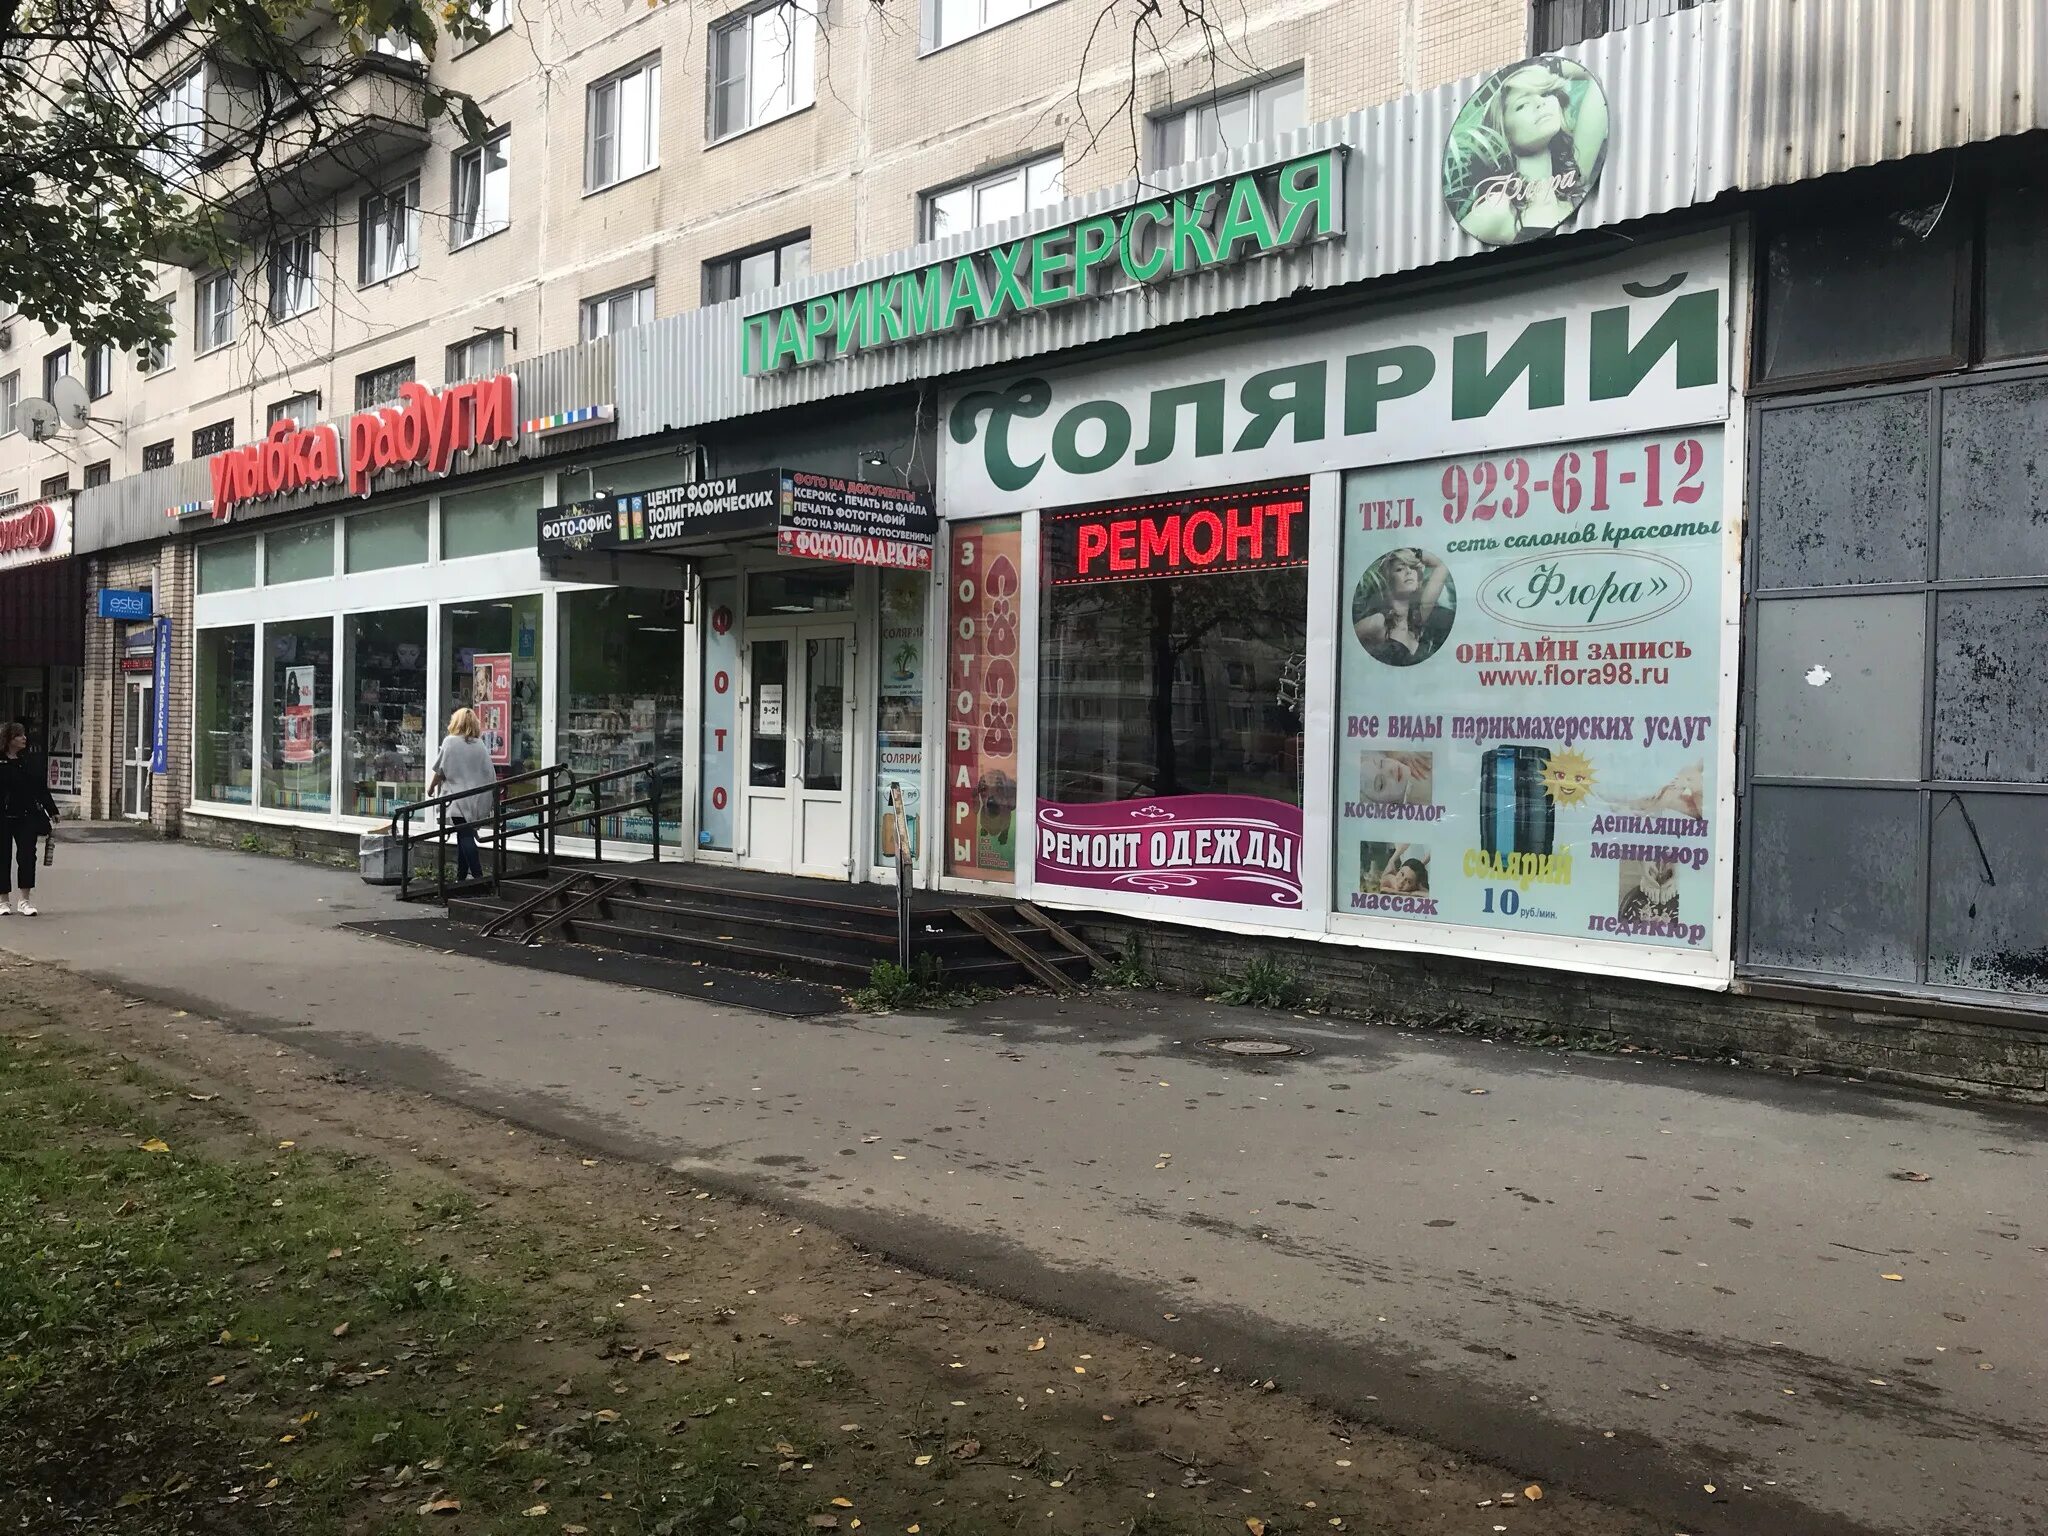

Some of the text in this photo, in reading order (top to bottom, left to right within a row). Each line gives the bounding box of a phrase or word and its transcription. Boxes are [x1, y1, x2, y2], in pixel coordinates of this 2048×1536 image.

[743, 150, 1331, 376] ПАРИКМАХЕРСКАЯ
[350, 374, 514, 497] радуги
[647, 477, 737, 507] ЦЕНТР ФОТО И
[794, 473, 916, 502] ФОТО НА ДОКУМЕНТЫ
[1359, 439, 1705, 531] ТЕЛ. 923-61-12
[648, 490, 774, 524] ПОЛИГРАФИЧЕСКИХ
[794, 487, 928, 516] КСЕРОКС ПЕЧАТЬ ИЗ ФАЙЛА
[794, 501, 906, 527] ПЕЧАТЬ ФОТОГРАФИЙ
[542, 513, 613, 539] ФОТО-ОФИС
[649, 521, 685, 540] УСЛУГ
[793, 516, 932, 543] ФОТО НА ЭМАЛИ ФОТОСУВЕНИРЫ
[1078, 501, 1303, 574] РЕМОНТ
[1446, 520, 1722, 553] сеть салонов красоты
[796, 532, 918, 567] ФОТОПОДАРКИ
[110, 597, 144, 611] estel
[1497, 562, 1668, 623] «Флора»
[1456, 636, 1692, 664] ОНЛАЙН ЗАПИСЬ
[157, 624, 167, 747] ПАРИКМАХЕРСКАЯ
[1478, 663, 1669, 688] www.flora98.ru
[712, 605, 733, 810] ФОТО
[954, 541, 975, 863] ЗООТОВАРЫ
[1347, 715, 1711, 748] все виды парикмахерских услуг
[881, 751, 922, 764] СОЛЯРИЙ
[1344, 801, 1447, 822] косметолог
[1592, 814, 1709, 838] депиляция
[1041, 826, 1292, 874] РЕМОНТ ОДЕЖДЫ
[1591, 840, 1709, 870] маникюр
[1463, 845, 1573, 891] солярий
[1351, 892, 1440, 916] массаж
[1482, 887, 1520, 915] 10
[1588, 913, 1706, 944] педикюр
